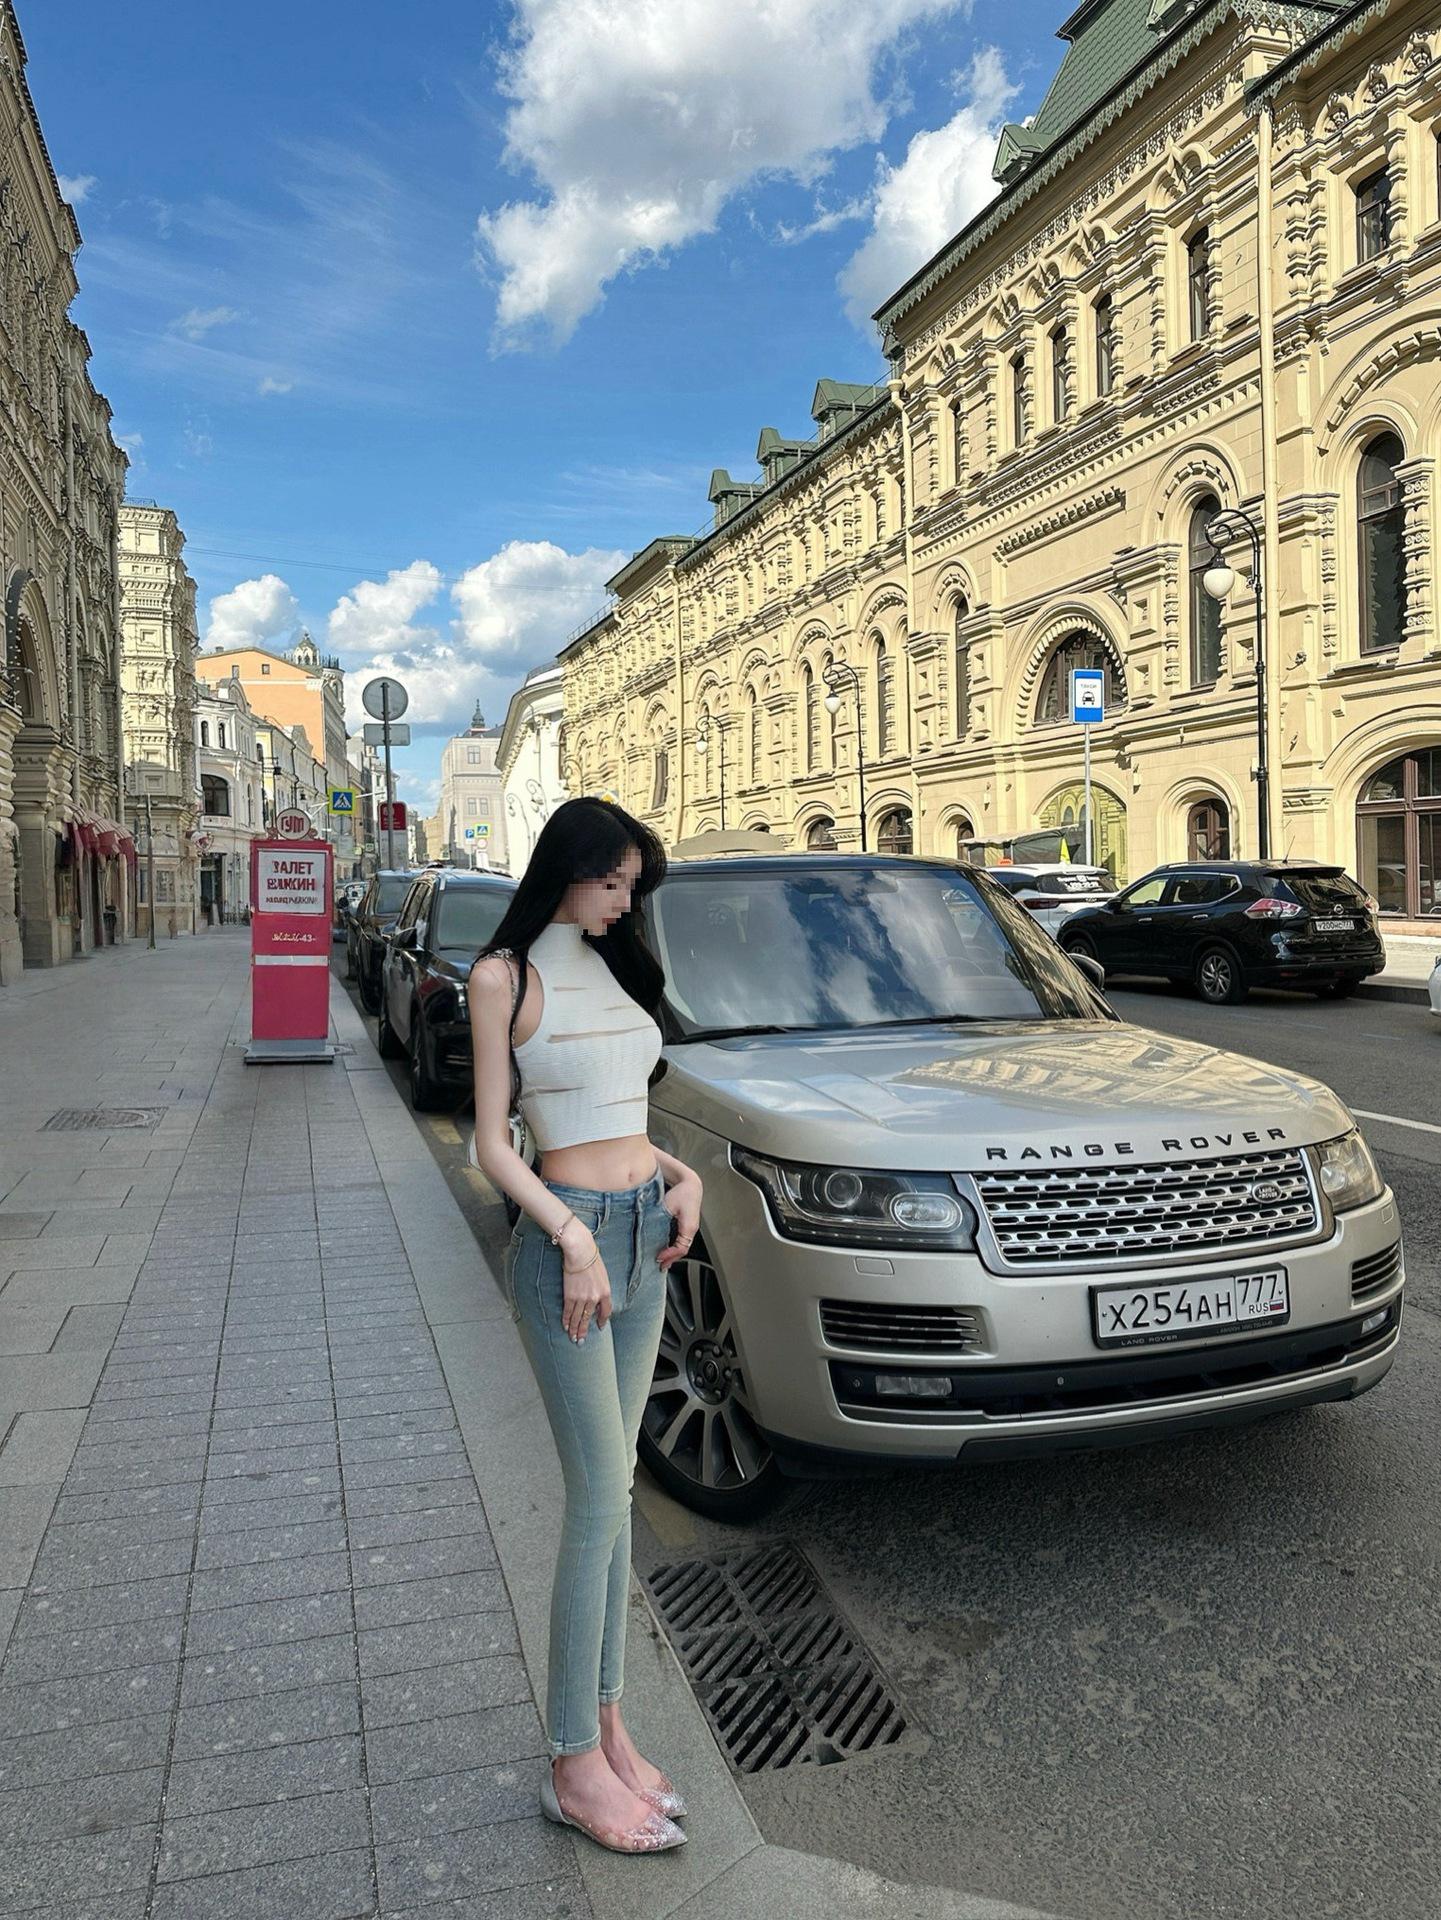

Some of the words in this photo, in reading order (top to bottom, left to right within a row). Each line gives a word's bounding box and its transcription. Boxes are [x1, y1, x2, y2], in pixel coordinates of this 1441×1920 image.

[986, 1142, 1134, 1160] RANGE
[1162, 1128, 1287, 1151] ROVER
[1237, 1274, 1278, 1305] 777
[1248, 1302, 1269, 1314] RUS
[1121, 1337, 1145, 1346] LAND
[1149, 1334, 1178, 1343] ROVER
